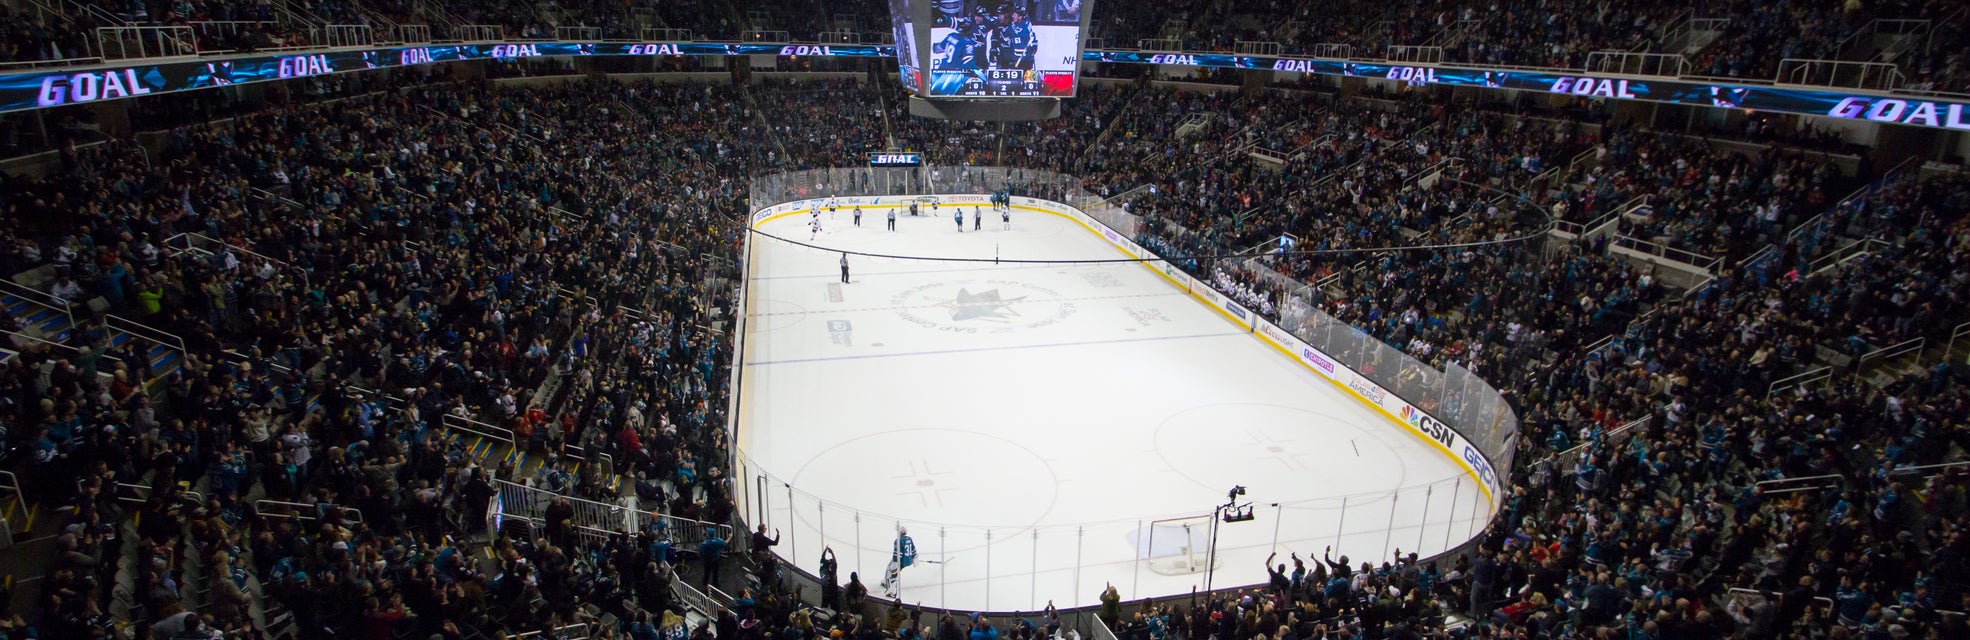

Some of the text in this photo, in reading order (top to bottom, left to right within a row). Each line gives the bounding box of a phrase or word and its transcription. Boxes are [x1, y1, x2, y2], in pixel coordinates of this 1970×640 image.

[401, 47, 433, 66] GOAL
[491, 43, 542, 58] GOAL
[628, 43, 684, 55] GOAL
[279, 54, 333, 79] GOAL
[1150, 54, 1198, 66] GOAL
[1273, 59, 1315, 73] GOAL
[992, 71, 1018, 79] 8:19
[1386, 66, 1439, 83] GOAL
[38, 68, 150, 107] GOAL
[1550, 76, 1635, 99] GOAL
[1826, 96, 1970, 130] GOAL
[1310, 352, 1334, 373] CHIPOTLE
[1349, 380, 1384, 408] AMERICA
[1419, 415, 1455, 449] CSN
[904, 543, 912, 557] 31
